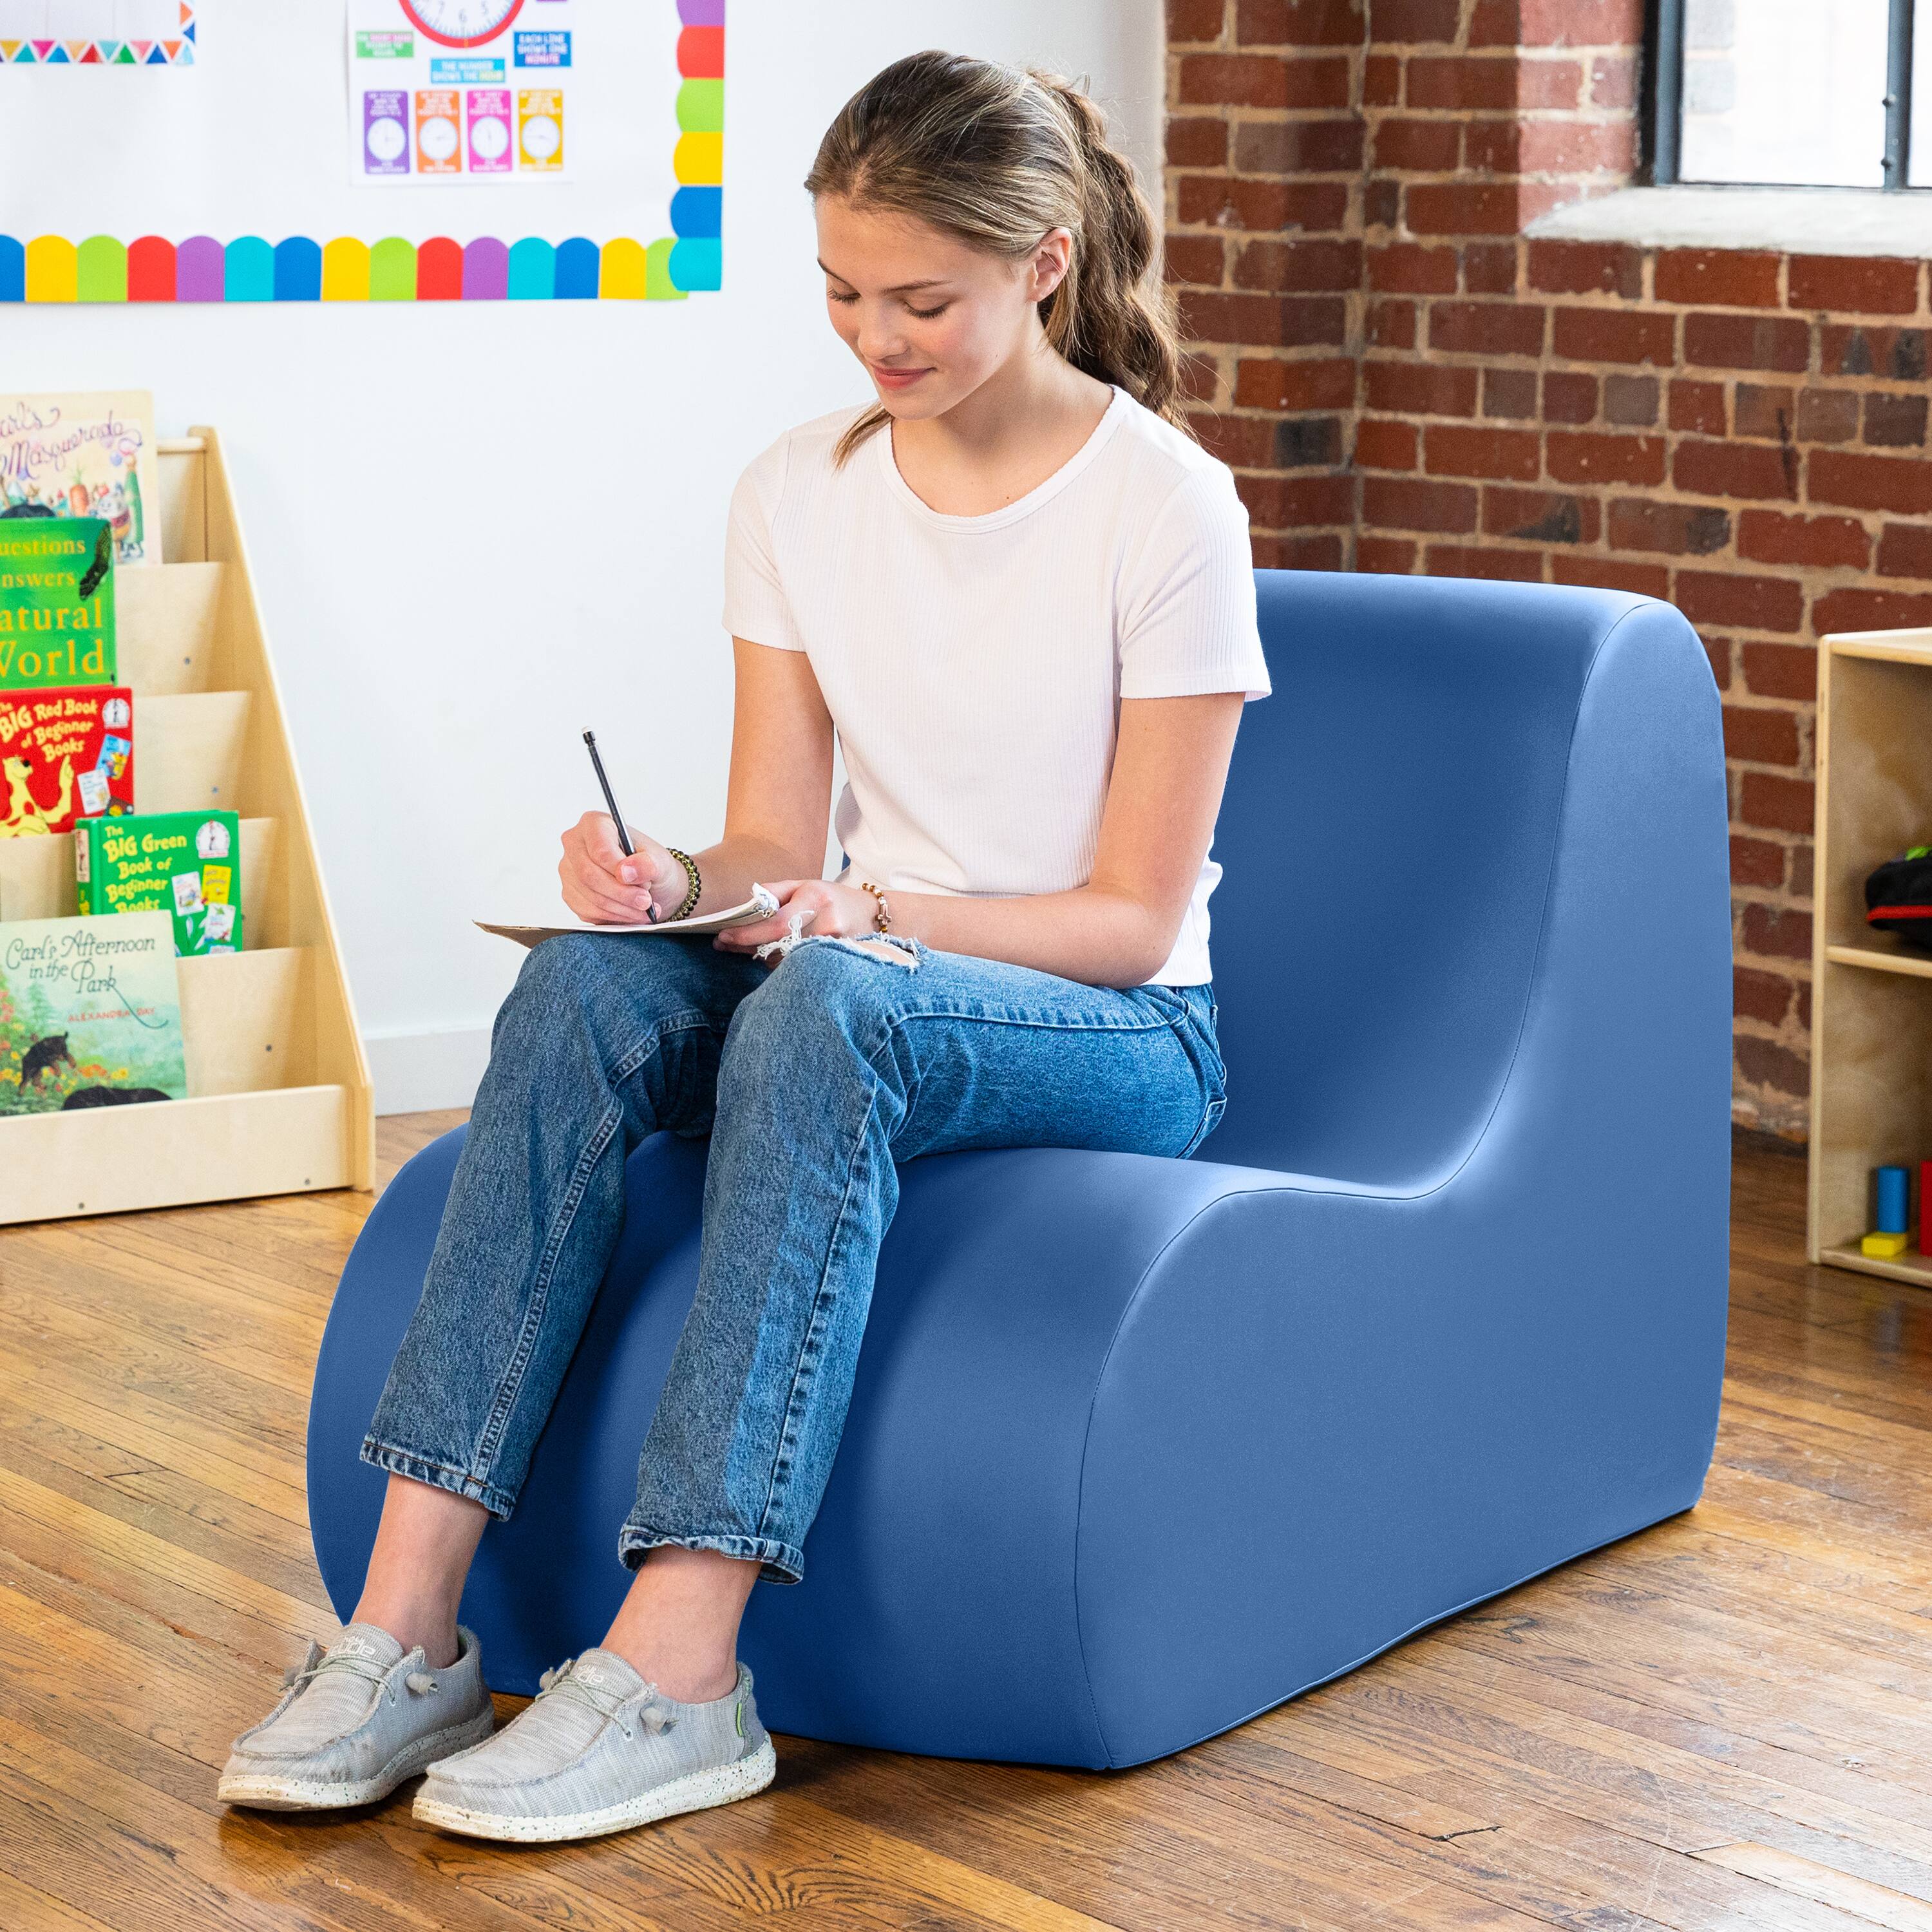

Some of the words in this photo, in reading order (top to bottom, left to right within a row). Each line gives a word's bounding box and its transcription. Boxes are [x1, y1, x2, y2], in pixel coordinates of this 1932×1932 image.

[0, 402, 61, 437] arl's
[0, 535, 86, 556] uestions
[2, 571, 75, 587] nswers
[0, 598, 102, 632] atural
[0, 705, 33, 743] BIG
[33, 699, 62, 721] Red
[64, 698, 97, 716] Book
[33, 721, 94, 745] Beginner
[42, 737, 84, 762] Books
[105, 826, 124, 838] The
[103, 835, 137, 863] BIG
[142, 833, 187, 853] Green
[118, 857, 153, 880] Book
[156, 857, 173, 870] of
[106, 879, 168, 903] Beginner
[6, 935, 57, 969] Carl's
[61, 930, 155, 957] Afternoon
[30, 965, 43, 979] in
[46, 958, 69, 982] the
[70, 958, 117, 994] Park
[68, 1009, 129, 1023] ALEXANDRA
[137, 1007, 155, 1016] DAY
